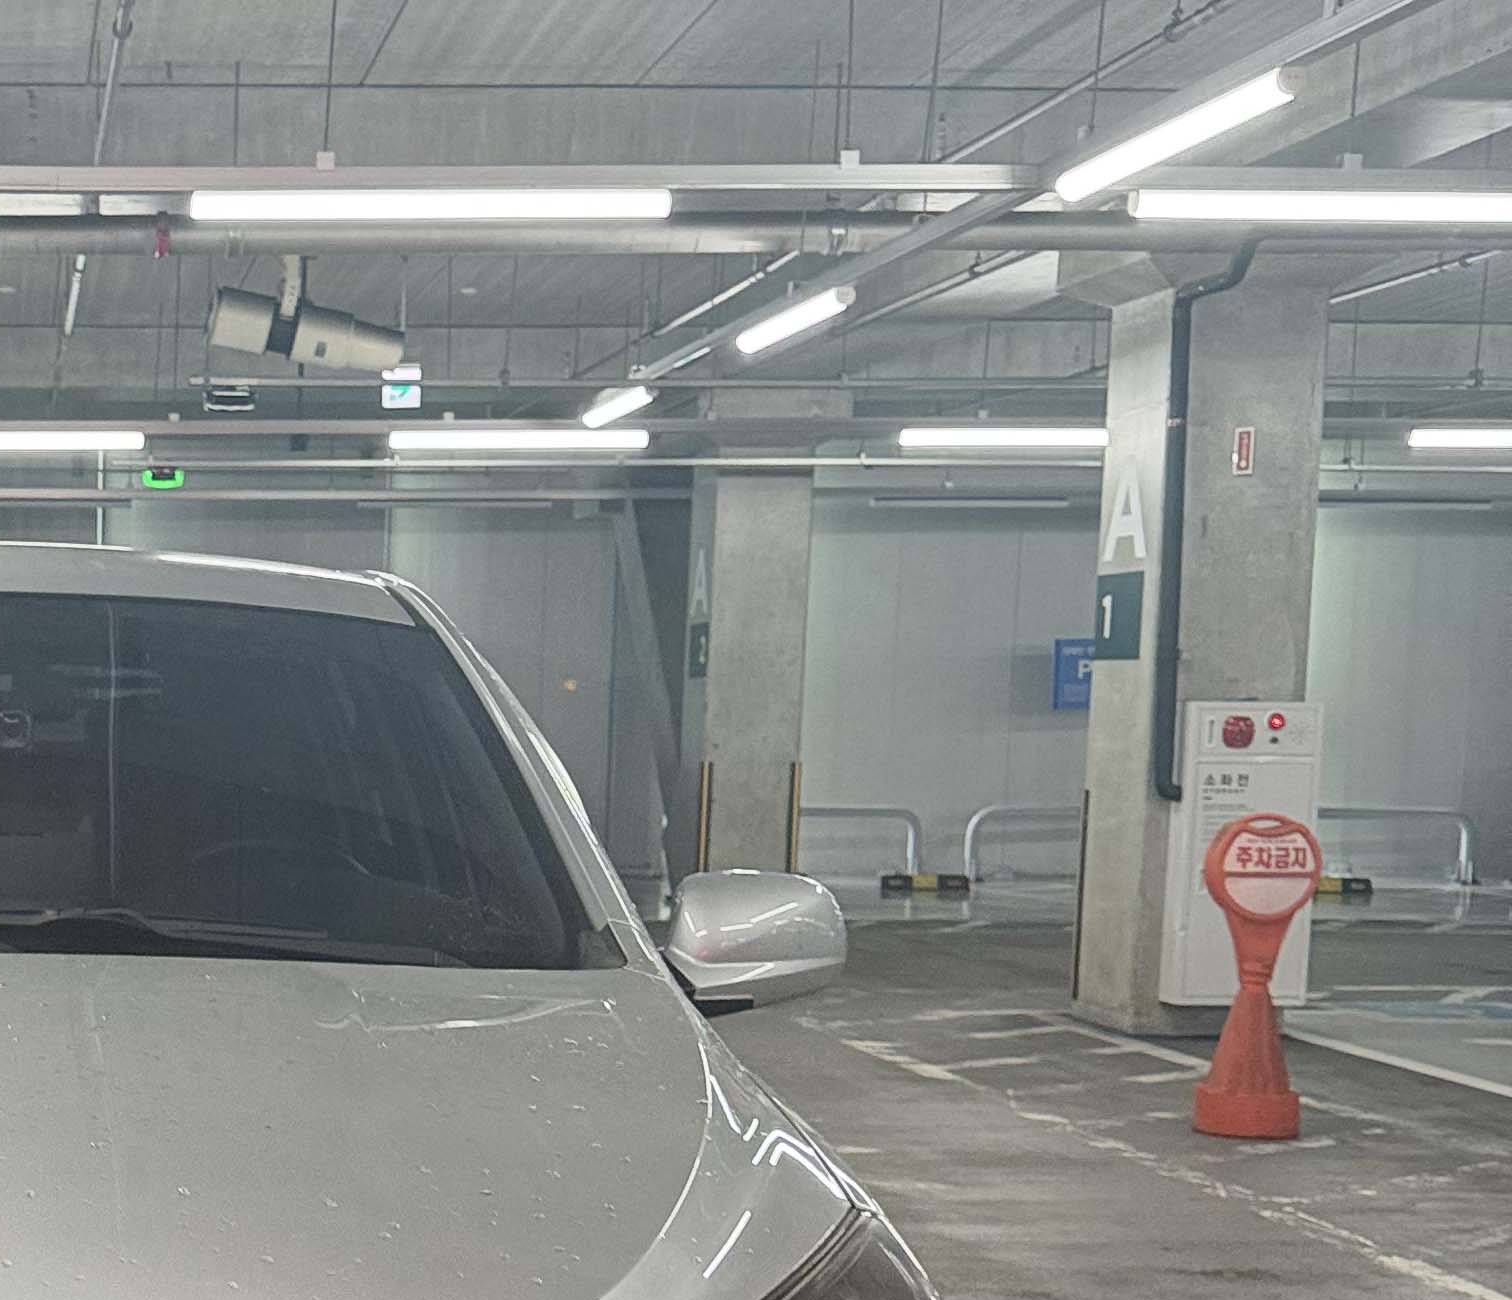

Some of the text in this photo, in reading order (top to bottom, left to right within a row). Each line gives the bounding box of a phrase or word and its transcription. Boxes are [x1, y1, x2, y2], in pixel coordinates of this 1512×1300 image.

[1102, 474, 1147, 562] A
[689, 549, 708, 616] A
[1102, 594, 1113, 640] 1
[1236, 846, 1308, 870] 주차금지
